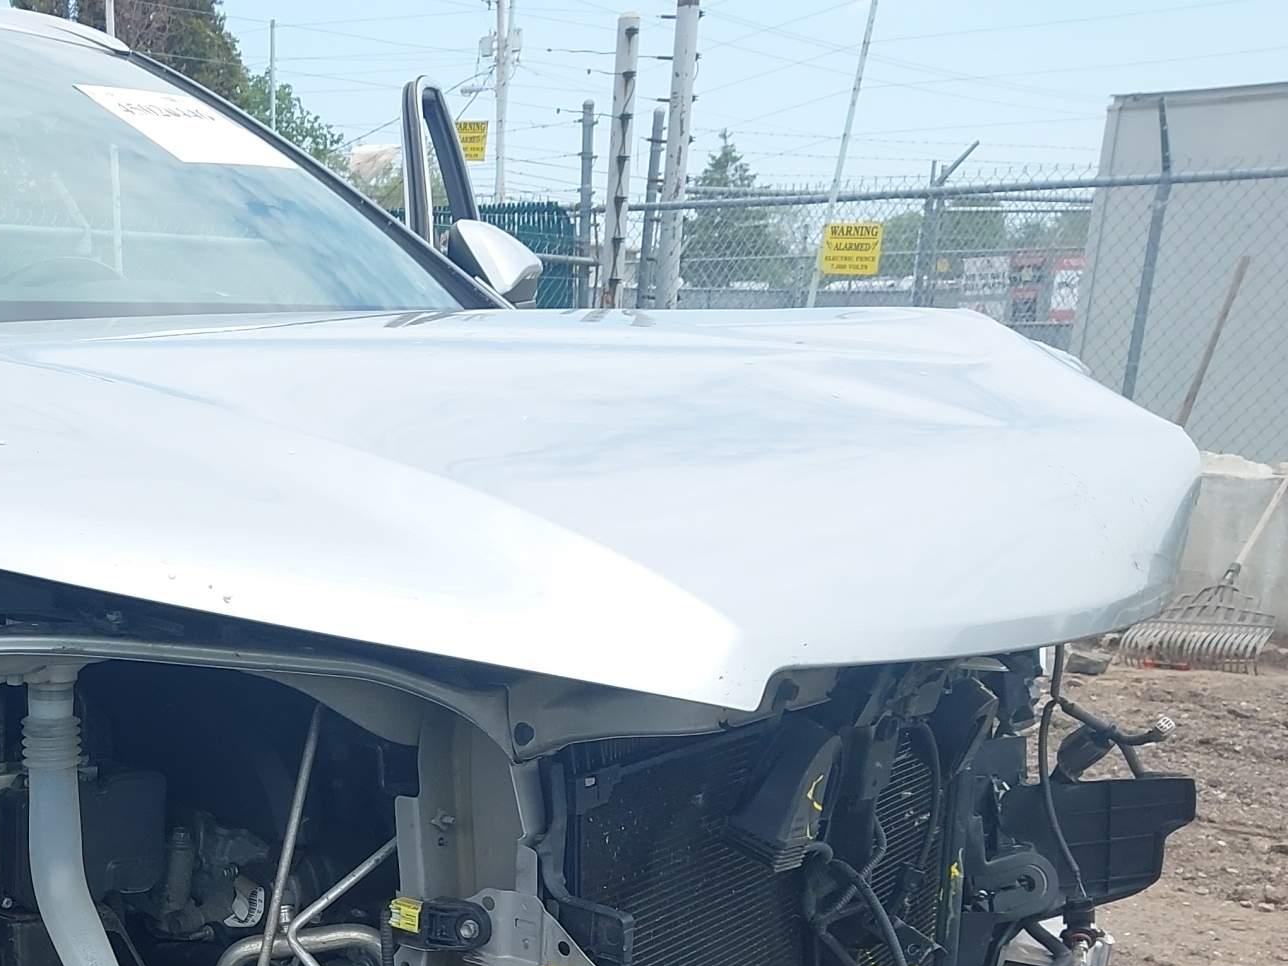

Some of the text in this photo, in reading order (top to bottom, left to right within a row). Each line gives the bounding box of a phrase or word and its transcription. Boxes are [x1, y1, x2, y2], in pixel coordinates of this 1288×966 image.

[456, 122, 486, 131] ARNING
[830, 225, 879, 237] WARNING
[833, 242, 871, 252] ALARMED
